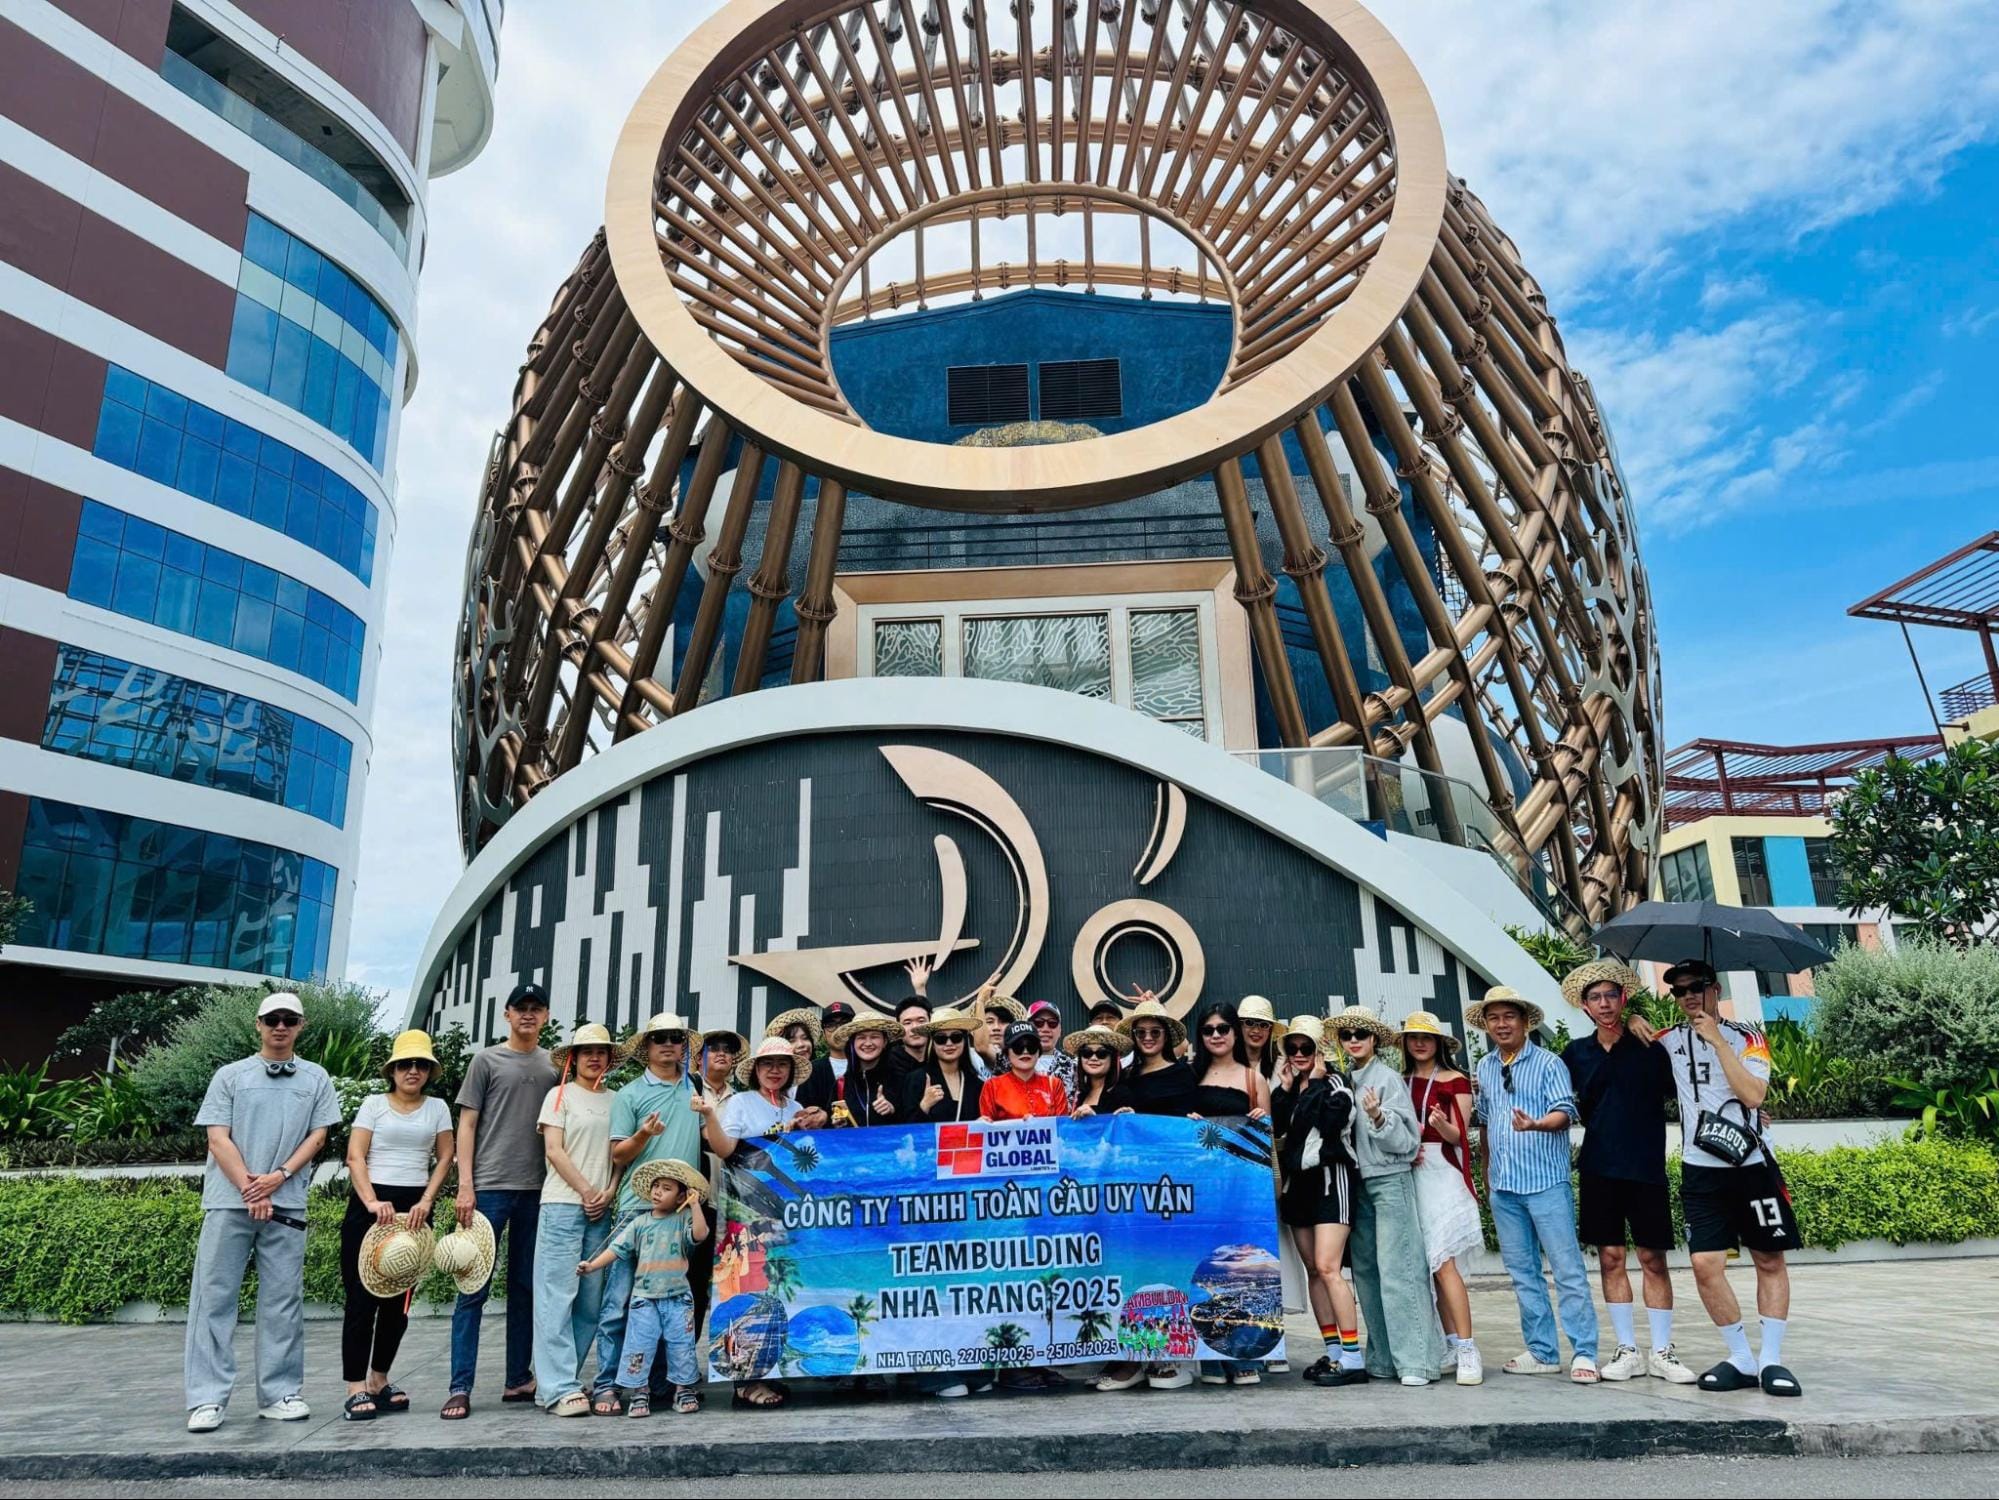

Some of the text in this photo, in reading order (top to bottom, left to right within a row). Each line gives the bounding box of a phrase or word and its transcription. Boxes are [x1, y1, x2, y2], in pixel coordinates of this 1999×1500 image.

[987, 1128, 1052, 1147] UY VAN
[1700, 1122, 1748, 1158] LEAGUE
[986, 1149, 1057, 1168] GLOBAL
[783, 1175, 1193, 1229] CÔNG TY TNHH TOÀN CẦU UY VẬN
[1750, 1197, 1783, 1227] 13
[890, 1234, 1102, 1275] TEAMBUILDING
[880, 1277, 1122, 1319] NHA TRANG 2025
[876, 1352, 904, 1368] NHA
[908, 1350, 955, 1367] TRANG,
[957, 1346, 1034, 1365] 22/05/2025
[1047, 1340, 1118, 1359] 25/05/2025
